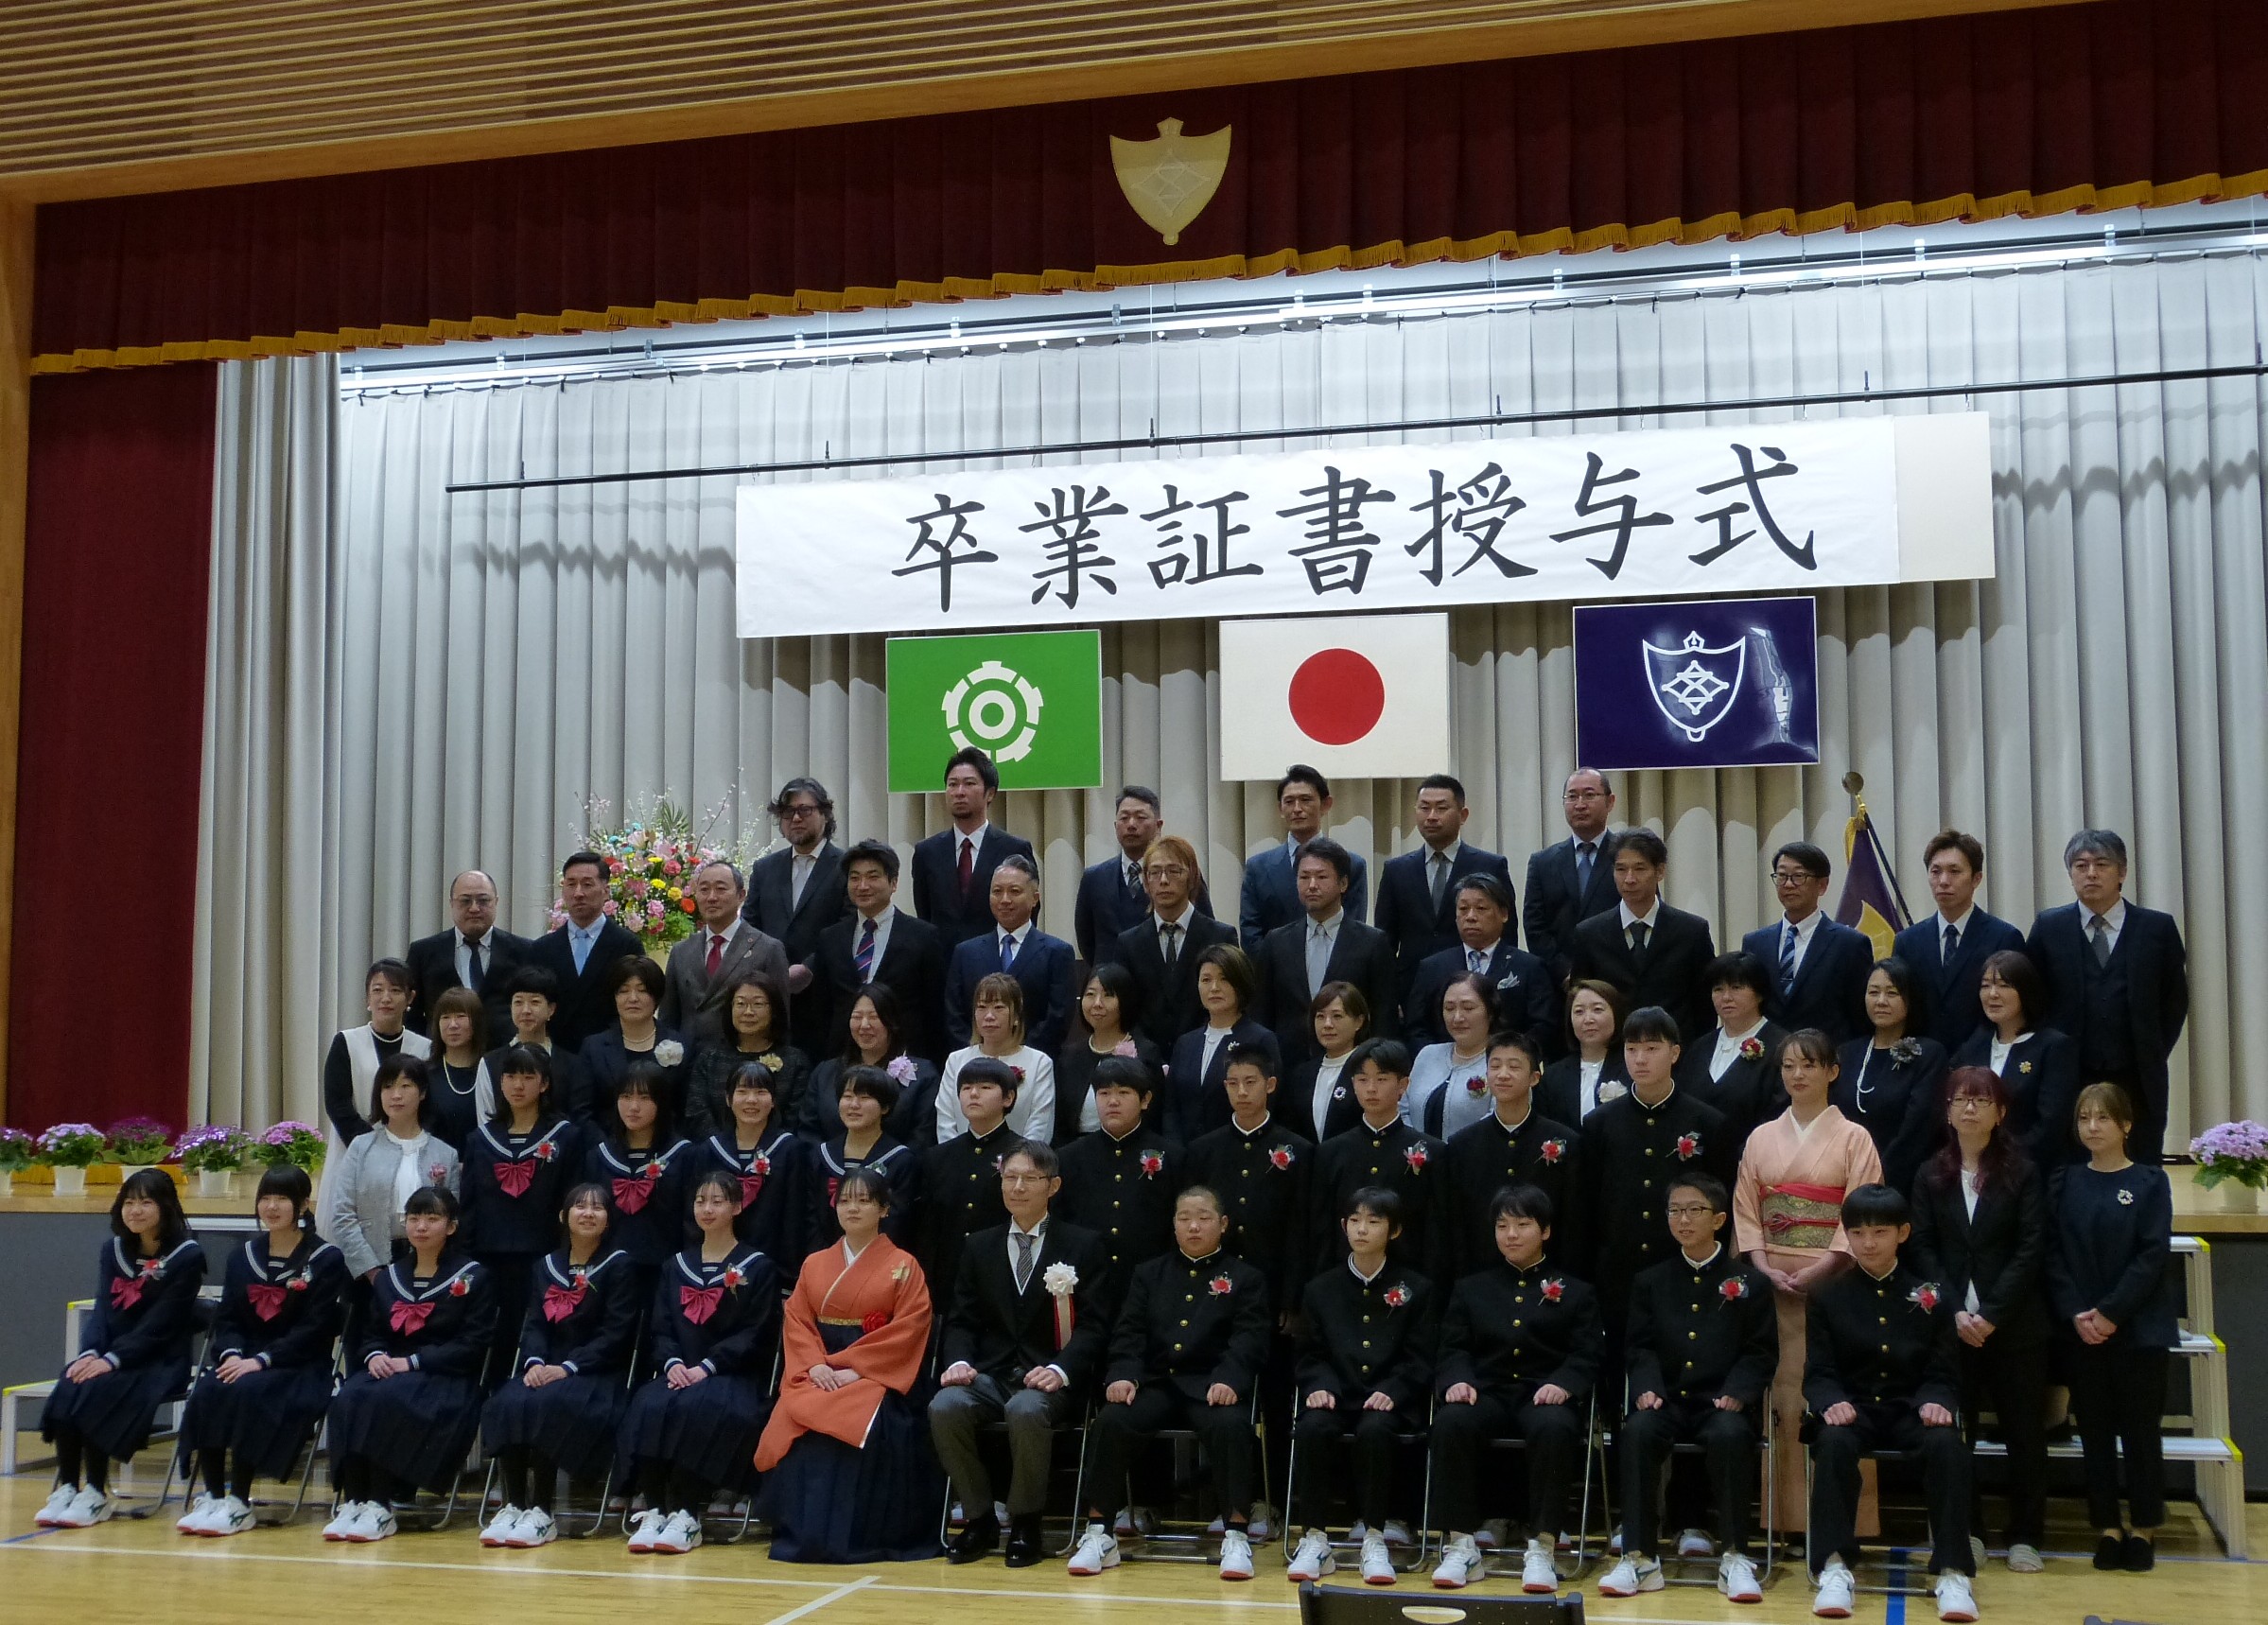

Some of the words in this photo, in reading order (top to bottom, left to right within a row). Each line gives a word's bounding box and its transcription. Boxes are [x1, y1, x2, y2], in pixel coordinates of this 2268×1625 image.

[891, 443, 1818, 613] 卒業証書授与式
